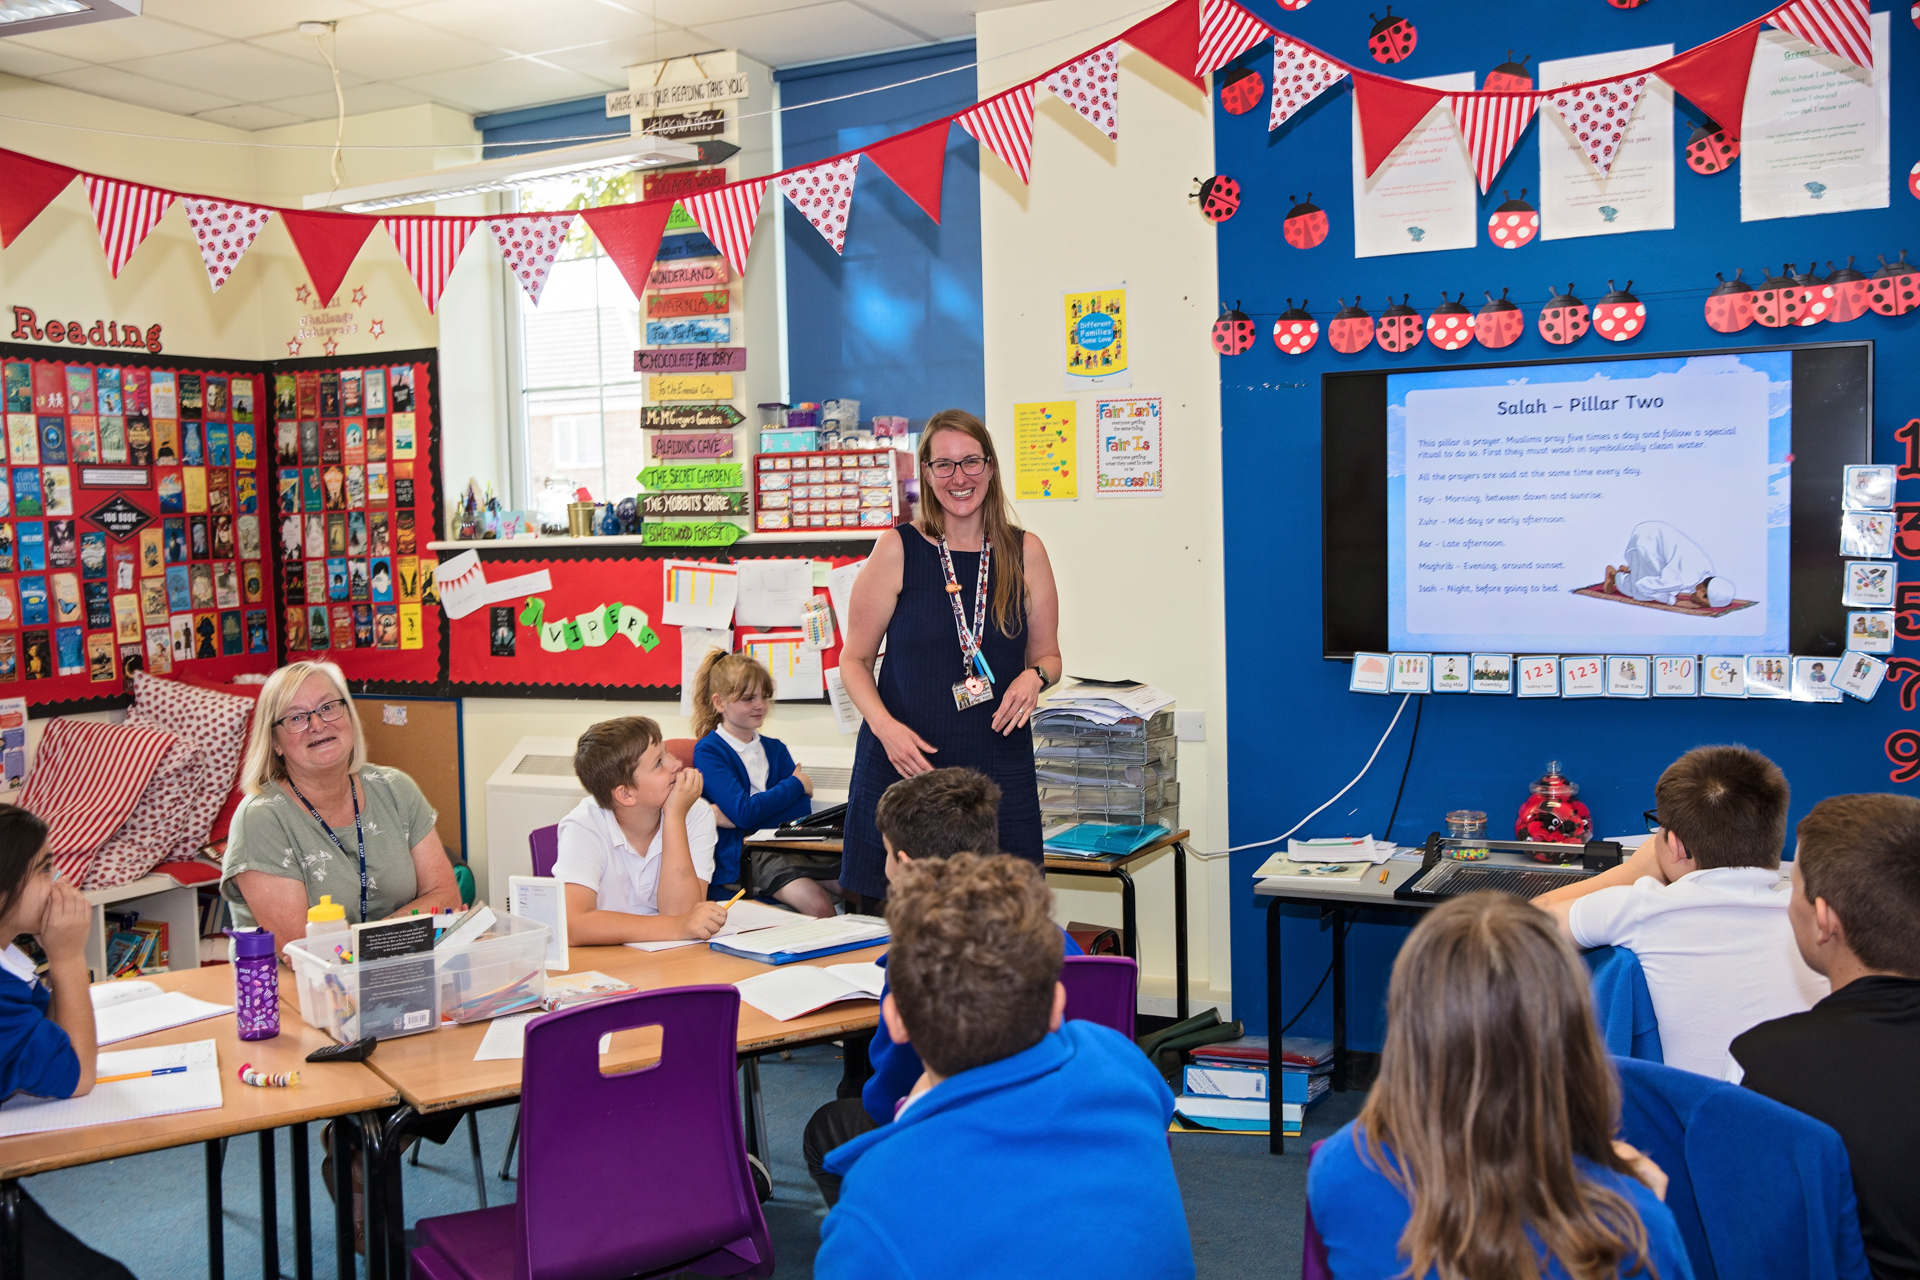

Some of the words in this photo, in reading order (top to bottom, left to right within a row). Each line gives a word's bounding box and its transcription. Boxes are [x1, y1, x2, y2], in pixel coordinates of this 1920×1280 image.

[1784, 48, 1811, 59] Green
[1778, 75, 1797, 83] What
[1821, 70, 1837, 78] done
[1839, 65, 1857, 75] well?
[608, 95, 632, 112] WHERE
[671, 83, 704, 104] READING
[706, 80, 724, 99] TAKE
[725, 74, 749, 95] YOU?
[1770, 88, 1791, 96] Which
[1792, 83, 1824, 94] behaviour
[1825, 81, 1836, 91] for
[1838, 77, 1865, 87] learning
[1791, 96, 1807, 104] have
[1813, 91, 1838, 101] shown?
[1784, 109, 1799, 117] How
[1819, 104, 1837, 112] move
[1839, 101, 1851, 109] on?
[650, 115, 714, 136] HOGWARTS
[1424, 135, 1457, 145] knowledge?
[1430, 147, 1444, 155] what
[1418, 157, 1441, 166] learned?
[652, 180, 669, 196] 100
[670, 178, 694, 194] ACRE
[695, 175, 721, 189] WOOD
[650, 266, 715, 285] WONDERLAND
[655, 298, 709, 314] NARNIA
[299, 312, 354, 327] Challenge
[1080, 320, 1112, 330] Different
[11, 304, 163, 354] Reading
[297, 325, 358, 340] Achievers
[652, 325, 668, 340] Far
[672, 323, 685, 339] Far
[686, 324, 710, 343] Away
[1080, 329, 1112, 338] Families
[638, 352, 693, 369] CHOCOLATE
[695, 351, 734, 370] FACTORY
[657, 380, 666, 396] To
[1099, 403, 1125, 420] Fair
[1126, 401, 1160, 418] Isn't
[1497, 398, 1548, 416] Salah
[1570, 394, 1620, 412] Pillar
[1625, 394, 1664, 410] Two
[646, 410, 660, 426] Mr
[696, 411, 724, 426] Garden
[1106, 436, 1131, 453] Fair
[1132, 436, 1151, 452] Is
[1418, 438, 1436, 448] This
[1438, 437, 1461, 449] pillar
[1463, 437, 1471, 446] is
[1473, 436, 1503, 449] prayer.
[1506, 434, 1543, 445] Muslims
[1544, 434, 1565, 445] pray
[1567, 432, 1584, 444] five
[1586, 432, 1611, 442] times
[1622, 430, 1640, 442] day
[1642, 429, 1661, 440] and
[1662, 428, 1693, 441] follow
[1703, 425, 1737, 439] special
[656, 438, 696, 456] ALADDINS
[697, 437, 722, 454] CAVE
[1418, 450, 1442, 460] ritual
[1444, 450, 1453, 459] to
[1455, 449, 1466, 458] do
[1468, 449, 1480, 458] so.
[1483, 447, 1503, 457] First
[1505, 447, 1524, 458] they
[1526, 447, 1549, 456] must
[1551, 445, 1574, 455] wash
[1576, 444, 1587, 454] in
[1589, 441, 1647, 455] symbolically
[1649, 440, 1675, 451] clean
[1677, 440, 1707, 450] water.
[647, 468, 668, 487] THE
[669, 467, 697, 485] SECRET
[697, 467, 733, 484] GARDEN
[1099, 470, 1161, 488] Successful!
[1418, 472, 1430, 482] All
[1432, 472, 1446, 481] the
[1448, 473, 1480, 483] prayers
[1482, 472, 1497, 480] are
[1499, 470, 1517, 480] said
[1519, 470, 1529, 479] at
[1531, 469, 1545, 478] the
[1547, 469, 1571, 478] same
[1573, 467, 1594, 477] time
[1596, 468, 1621, 478] every
[1622, 466, 1644, 478] day.
[643, 495, 663, 513] THE
[663, 494, 702, 513] HOBBITS
[702, 494, 730, 512] SHIRE
[1418, 494, 1436, 506] Fajr
[1445, 493, 1483, 504] Morning,
[1485, 492, 1521, 502] between
[1523, 491, 1548, 501] dawn
[1550, 490, 1568, 501] and
[1569, 490, 1605, 500] sunrise.
[118, 512, 137, 523] BOOK
[1418, 517, 1439, 526] Zuhr
[1448, 516, 1484, 527] Mid-day
[1485, 517, 1496, 525] or
[1497, 515, 1521, 527] early
[1522, 514, 1568, 527] afternoon.
[648, 525, 694, 543] SHERWOOD
[694, 524, 727, 541] FOREST
[1442, 540, 1461, 548] Late
[1462, 538, 1507, 550] afternoon.
[1418, 561, 1454, 573] Maghrib
[1463, 560, 1500, 571] Evening,
[1501, 560, 1533, 570] around
[1535, 560, 1567, 570] sunset.
[1447, 583, 1473, 594] Night,
[1475, 583, 1503, 595] before
[1504, 584, 1525, 595] going
[1530, 584, 1541, 593] to
[1542, 583, 1561, 593] bed.
[548, 608, 655, 645] VIPERS
[1524, 669, 1532, 681] 1
[1533, 666, 1543, 678] 2
[1544, 662, 1554, 674] 3
[1568, 669, 1576, 681] 1
[1577, 666, 1587, 678] 2
[1588, 662, 1598, 674] 3
[1402, 679, 1421, 687] Register
[1439, 681, 1453, 689] Daily
[1479, 681, 1503, 689] Assembly
[1884, 656, 1920, 712] 7
[1884, 728, 1920, 784] 9
[311, 809, 324, 824] STAFF
